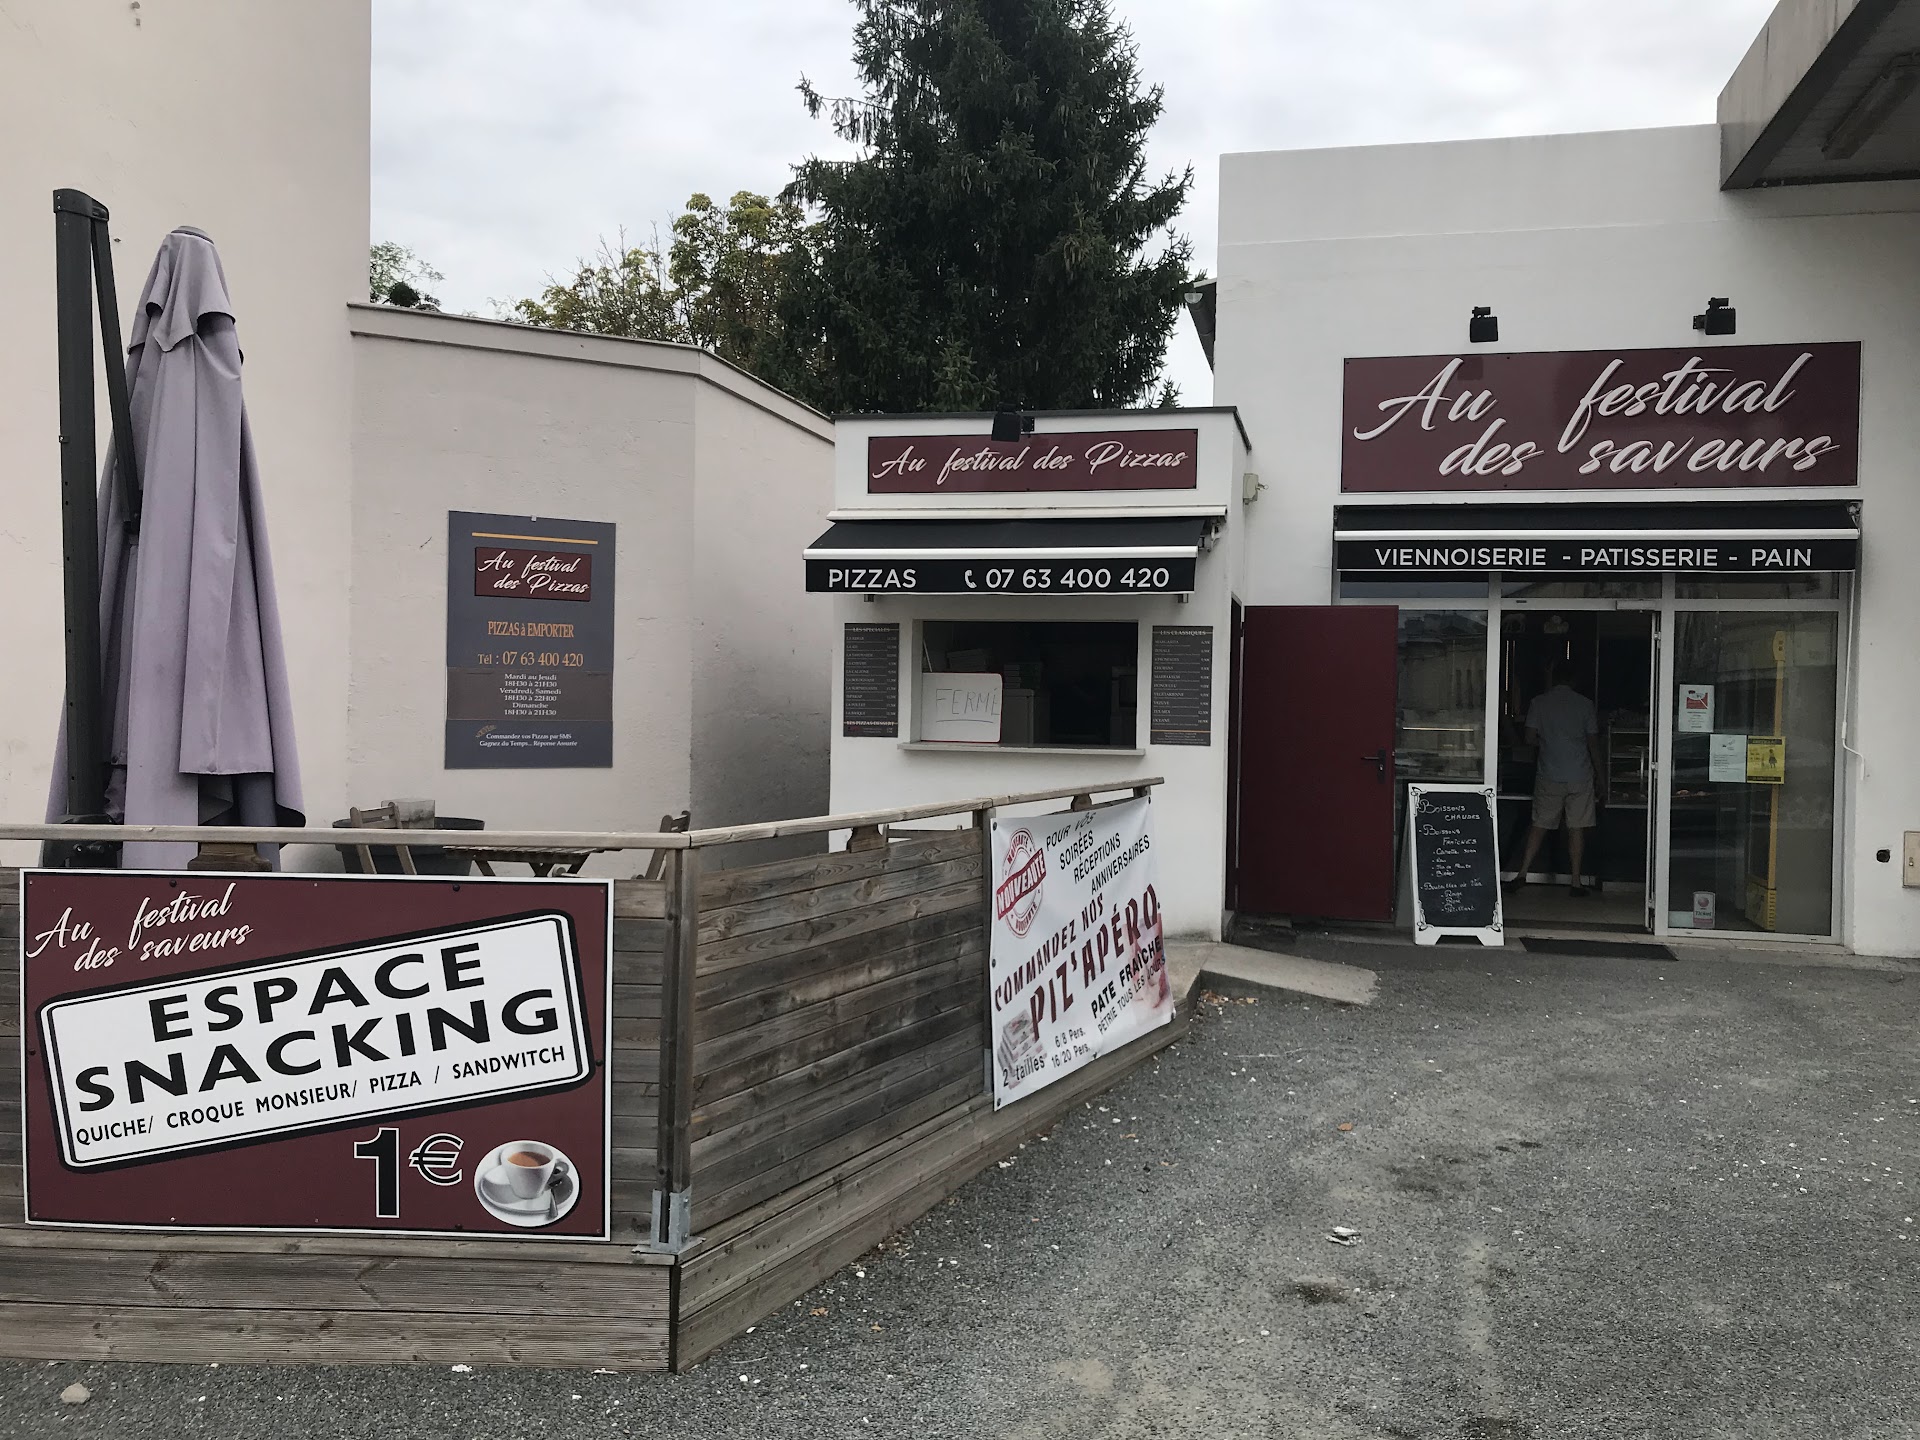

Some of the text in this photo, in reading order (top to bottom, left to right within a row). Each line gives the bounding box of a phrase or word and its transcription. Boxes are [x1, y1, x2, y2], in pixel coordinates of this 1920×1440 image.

[1353, 351, 1814, 453] Au festival
[872, 440, 1189, 485] Au festival des Pizzas
[1438, 418, 1840, 477] des saveurs
[477, 550, 581, 578] Au festival
[828, 567, 1169, 589] PIZZAS 07 63 400 420
[1375, 547, 1546, 567] VIENNOISERIE
[1580, 547, 1718, 567] PATISSERIE
[1750, 547, 1812, 567] PAIN
[494, 573, 589, 594] des Pizzas
[488, 620, 574, 638] PIZZAS à EMPORTER
[502, 651, 517, 666] 07
[520, 652, 535, 666] 63
[538, 652, 559, 667] 400
[562, 653, 584, 667] 420
[936, 688, 1001, 716] FERMÉ
[1046, 824, 1071, 851] POUR
[1060, 830, 1094, 870] SOIRÉES
[1074, 832, 1121, 884] RÉCEPTIONS
[1092, 834, 1150, 895] ANNIVERSAIRES
[26, 882, 236, 959] Au festival
[73, 922, 255, 973] des saveurs
[995, 893, 1103, 1012] COMMANDEZ NOS
[1030, 883, 1158, 1043] PIZ'APÉRO
[150, 942, 486, 1044] ESPACE
[1091, 935, 1162, 1019] PATE FRAICHE
[1118, 988, 1134, 1011] TOUS
[1134, 975, 1145, 994] LES
[75, 988, 560, 1113] SNACKING
[1051, 1041, 1091, 1069] 16/20 Pers.
[1055, 1026, 1086, 1048] 6/8 Pers.
[166, 1099, 245, 1130] CROQUE
[369, 1071, 423, 1095] PIZZA
[452, 1045, 566, 1080] SANDWITCH
[1002, 1055, 1045, 1088] 2 tailles
